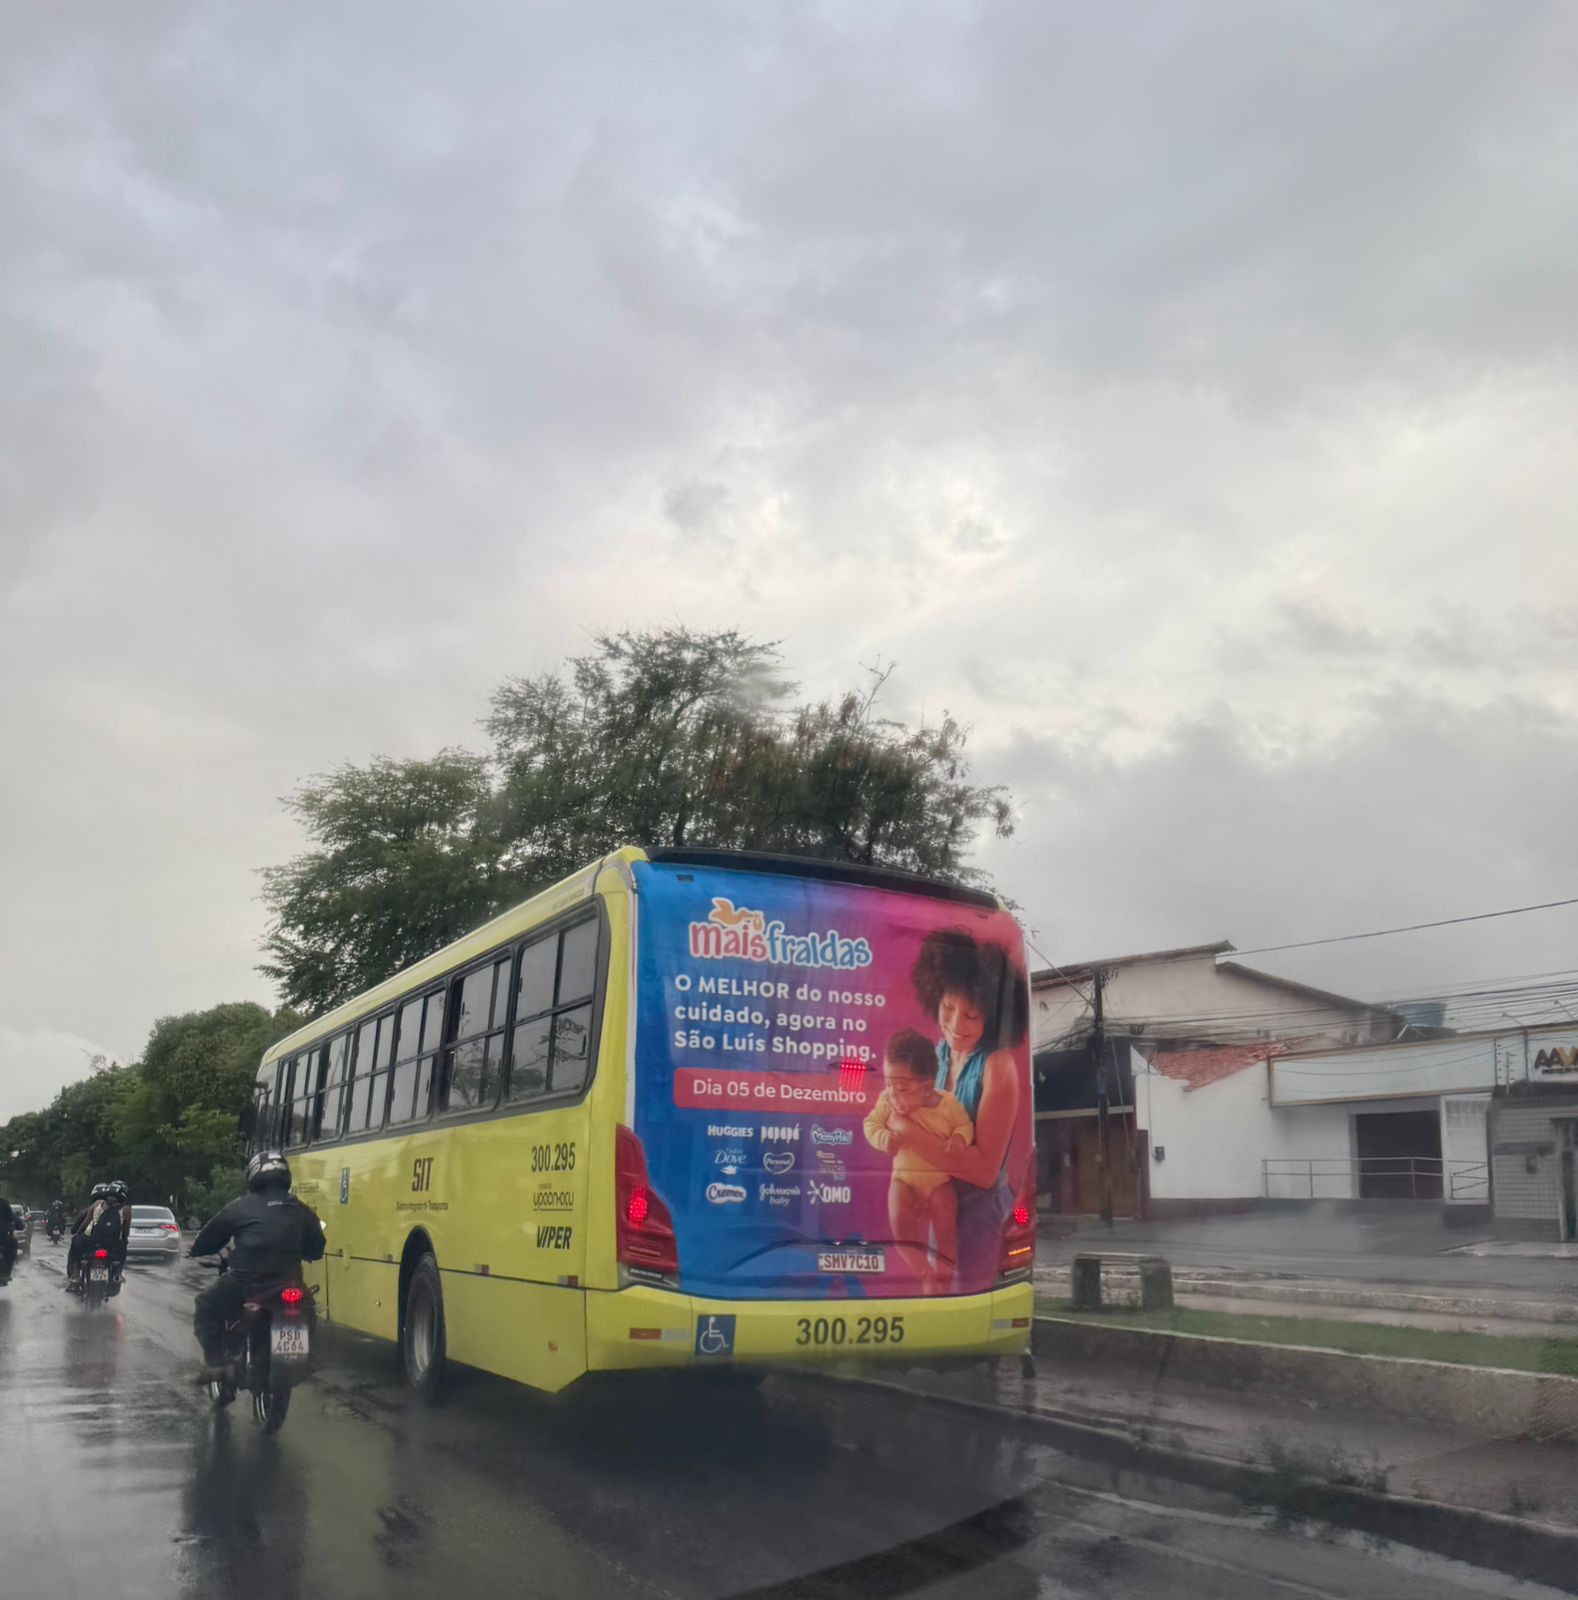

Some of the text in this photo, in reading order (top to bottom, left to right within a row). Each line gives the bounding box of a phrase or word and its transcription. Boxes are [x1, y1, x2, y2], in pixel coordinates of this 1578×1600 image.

[674, 974, 886, 1007] O MELHOR do nosso
[674, 1001, 867, 1032] cuidado, agora no
[674, 1030, 877, 1062] São Luís Shopping.
[693, 1078, 867, 1104] Dia 05 de Dezembro
[707, 1125, 754, 1137] HUGGIES
[531, 1142, 576, 1173] 300.295
[412, 1156, 434, 1192] SIT
[823, 1185, 851, 1203] OMO
[536, 1225, 573, 1250] VIPER
[795, 1316, 905, 1346] 300.295
